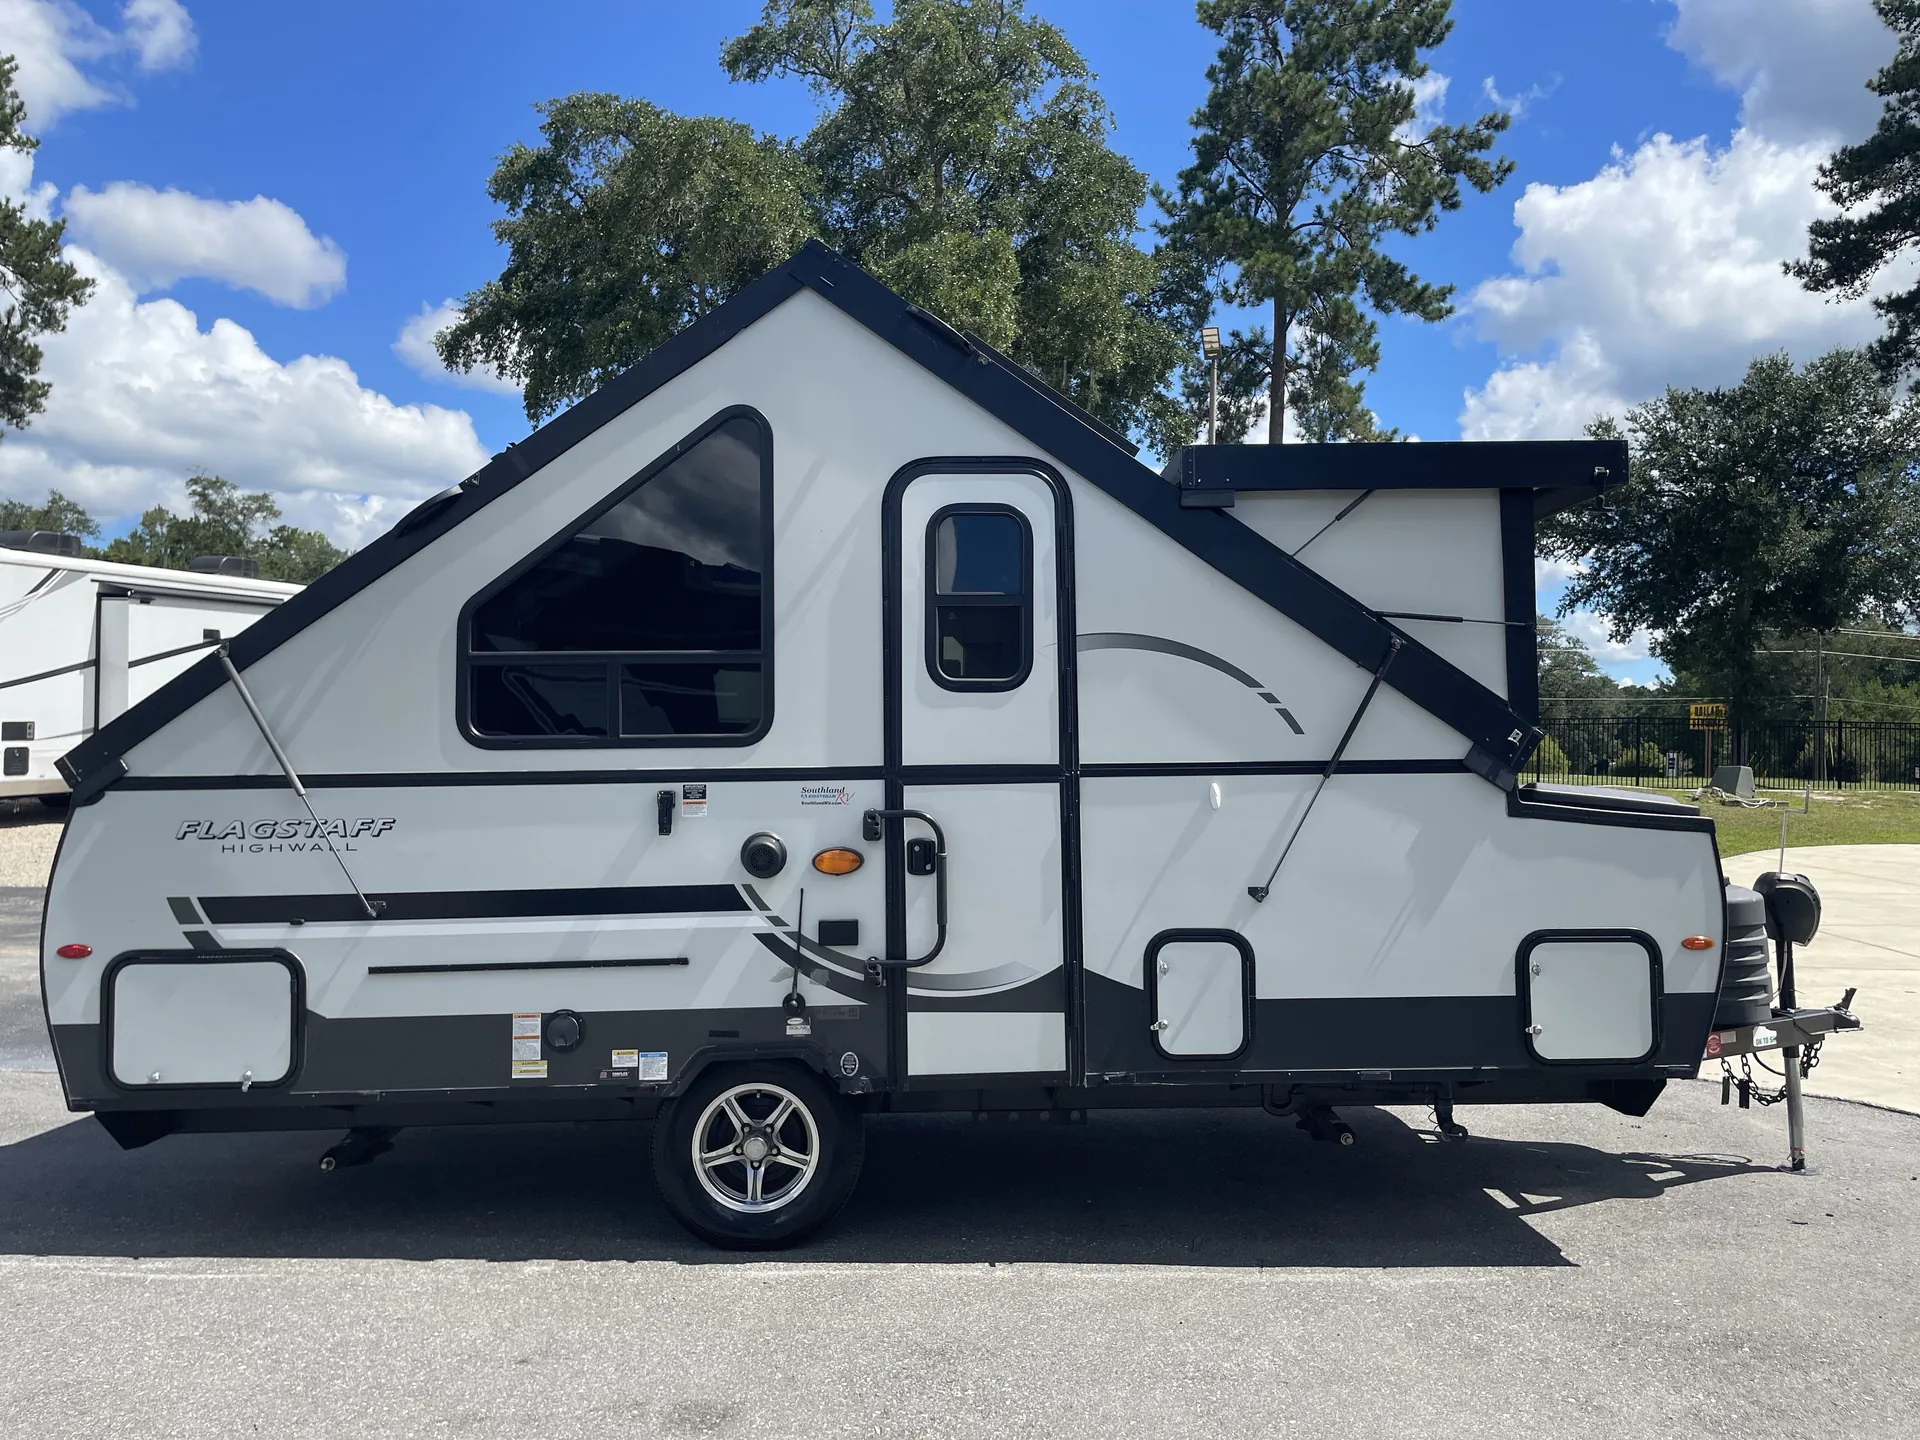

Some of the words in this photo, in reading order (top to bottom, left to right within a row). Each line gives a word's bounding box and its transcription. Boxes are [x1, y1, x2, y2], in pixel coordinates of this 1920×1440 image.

[836, 792, 856, 805] RV
[175, 818, 396, 840] FLAGSTAFF
[221, 842, 358, 853] HIGHWALL
